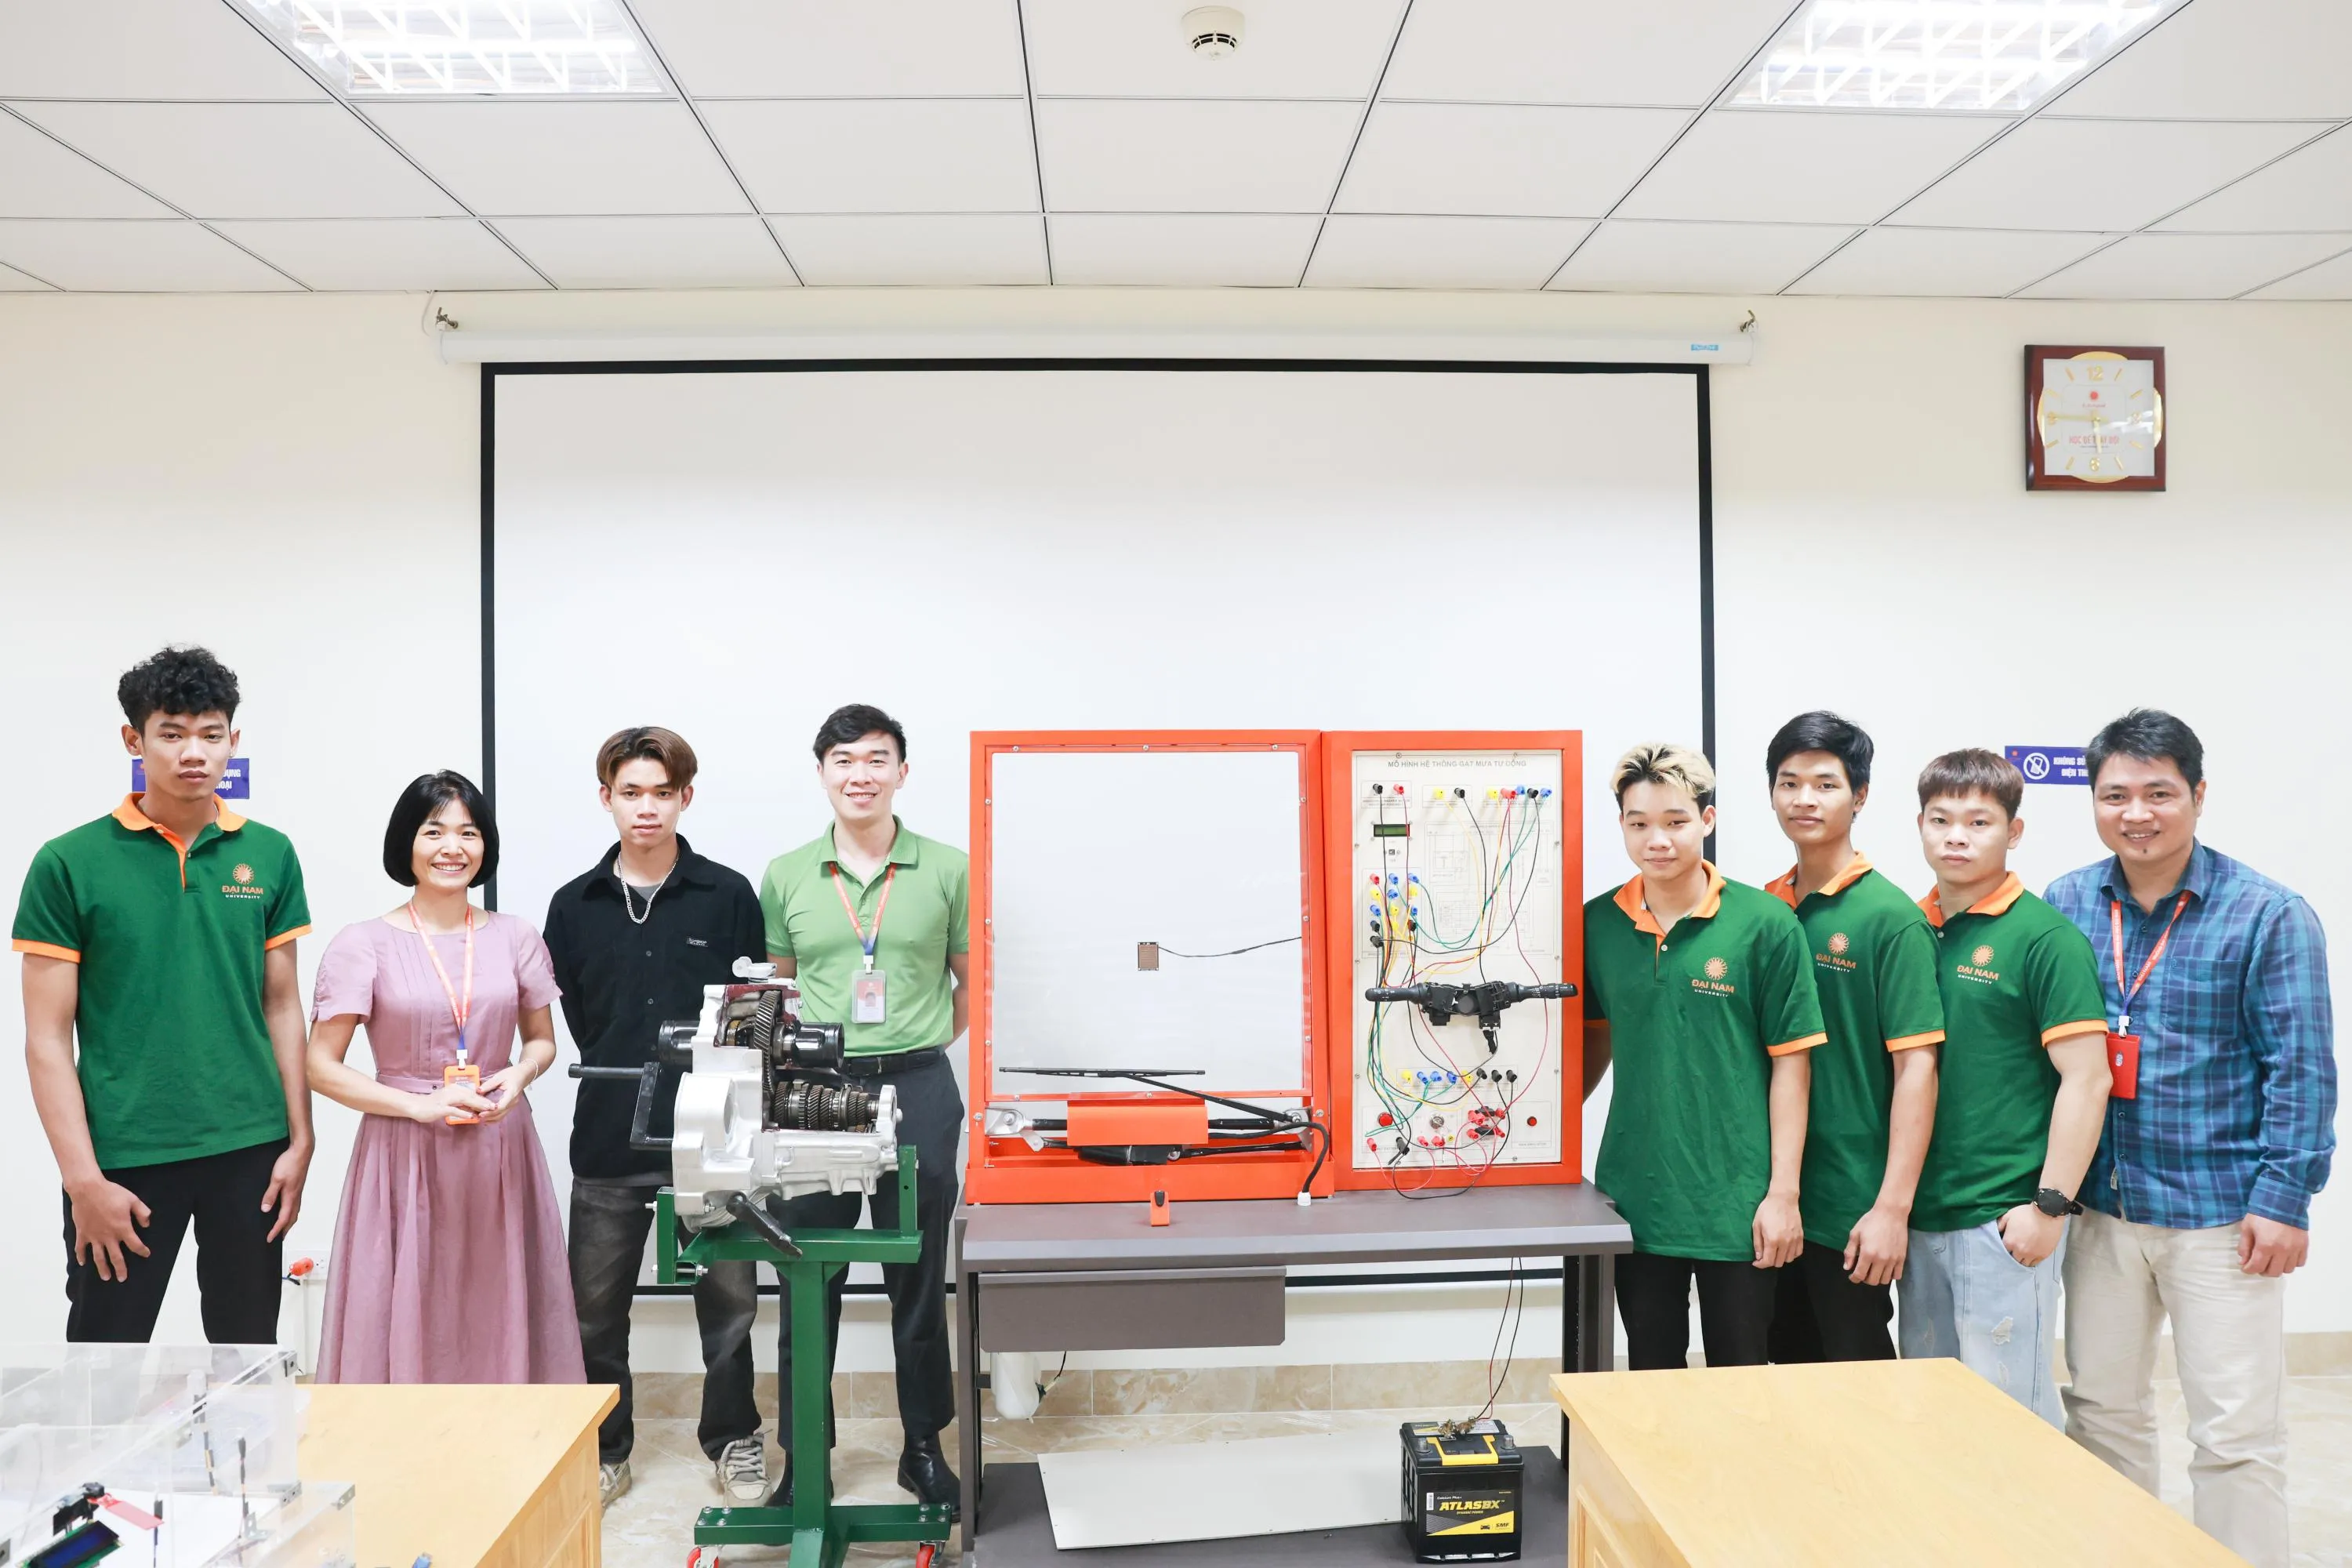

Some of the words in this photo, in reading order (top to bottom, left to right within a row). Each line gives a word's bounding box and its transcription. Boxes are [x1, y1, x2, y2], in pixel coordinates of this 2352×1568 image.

[2087, 365, 2103, 381] 12
[2053, 756, 2076, 765] KHÔNG
[242, 886, 263, 895] NAM
[1694, 988, 1729, 997] UNIVERSITY
[1711, 982, 1734, 993] NAM
[1439, 1500, 1501, 1511] ATLASBX
